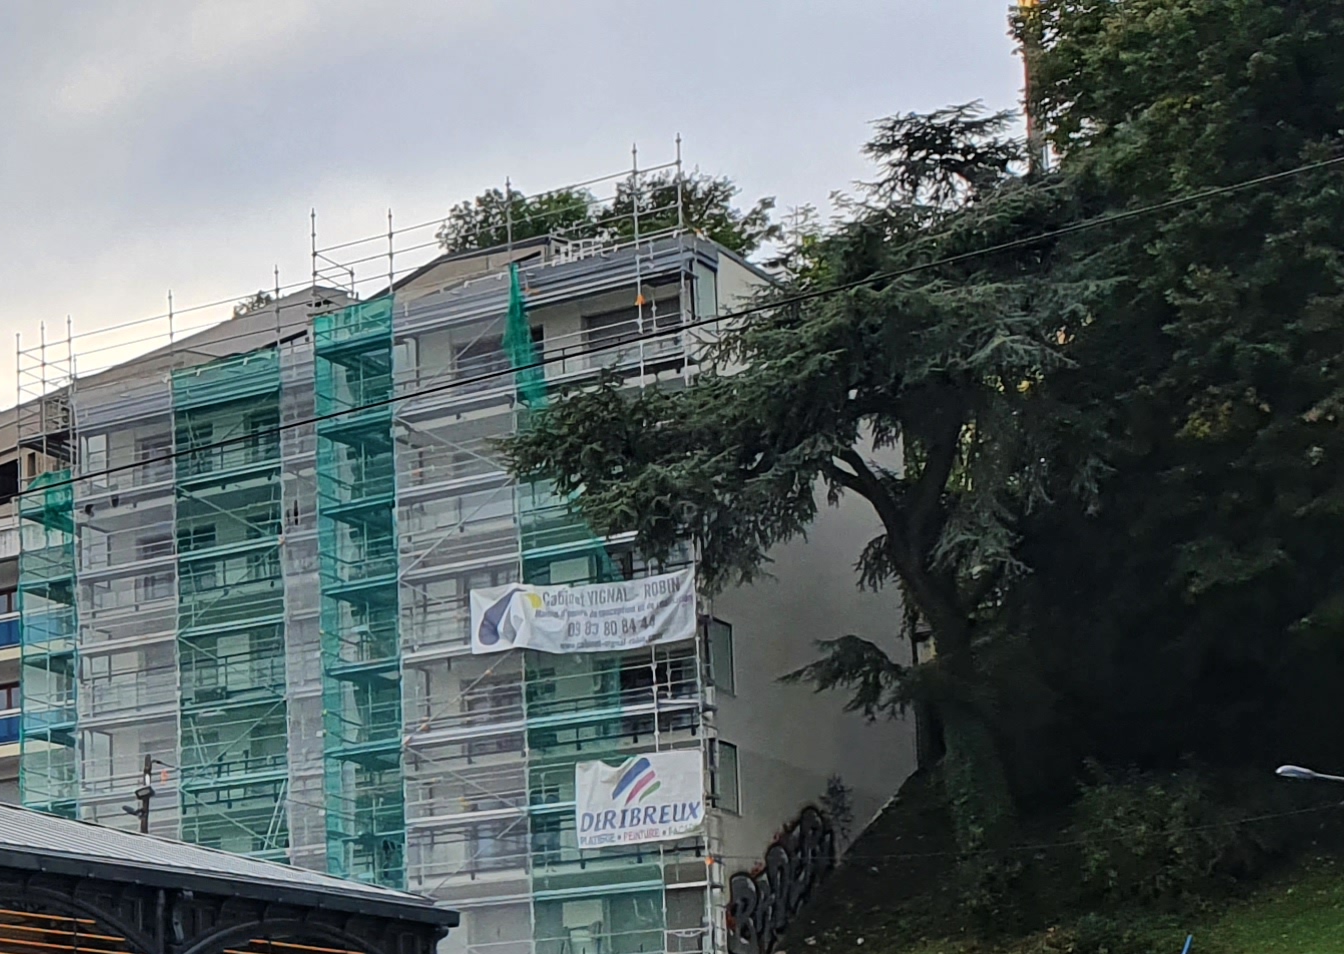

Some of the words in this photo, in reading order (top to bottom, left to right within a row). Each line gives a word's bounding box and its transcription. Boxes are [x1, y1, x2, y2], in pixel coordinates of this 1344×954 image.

[543, 588, 584, 607] Cabinet
[587, 587, 628, 606] VIGNAL
[644, 576, 680, 599] ROBIN
[568, 621, 581, 637] 09
[604, 620, 617, 636] 80
[622, 617, 636, 634] 84
